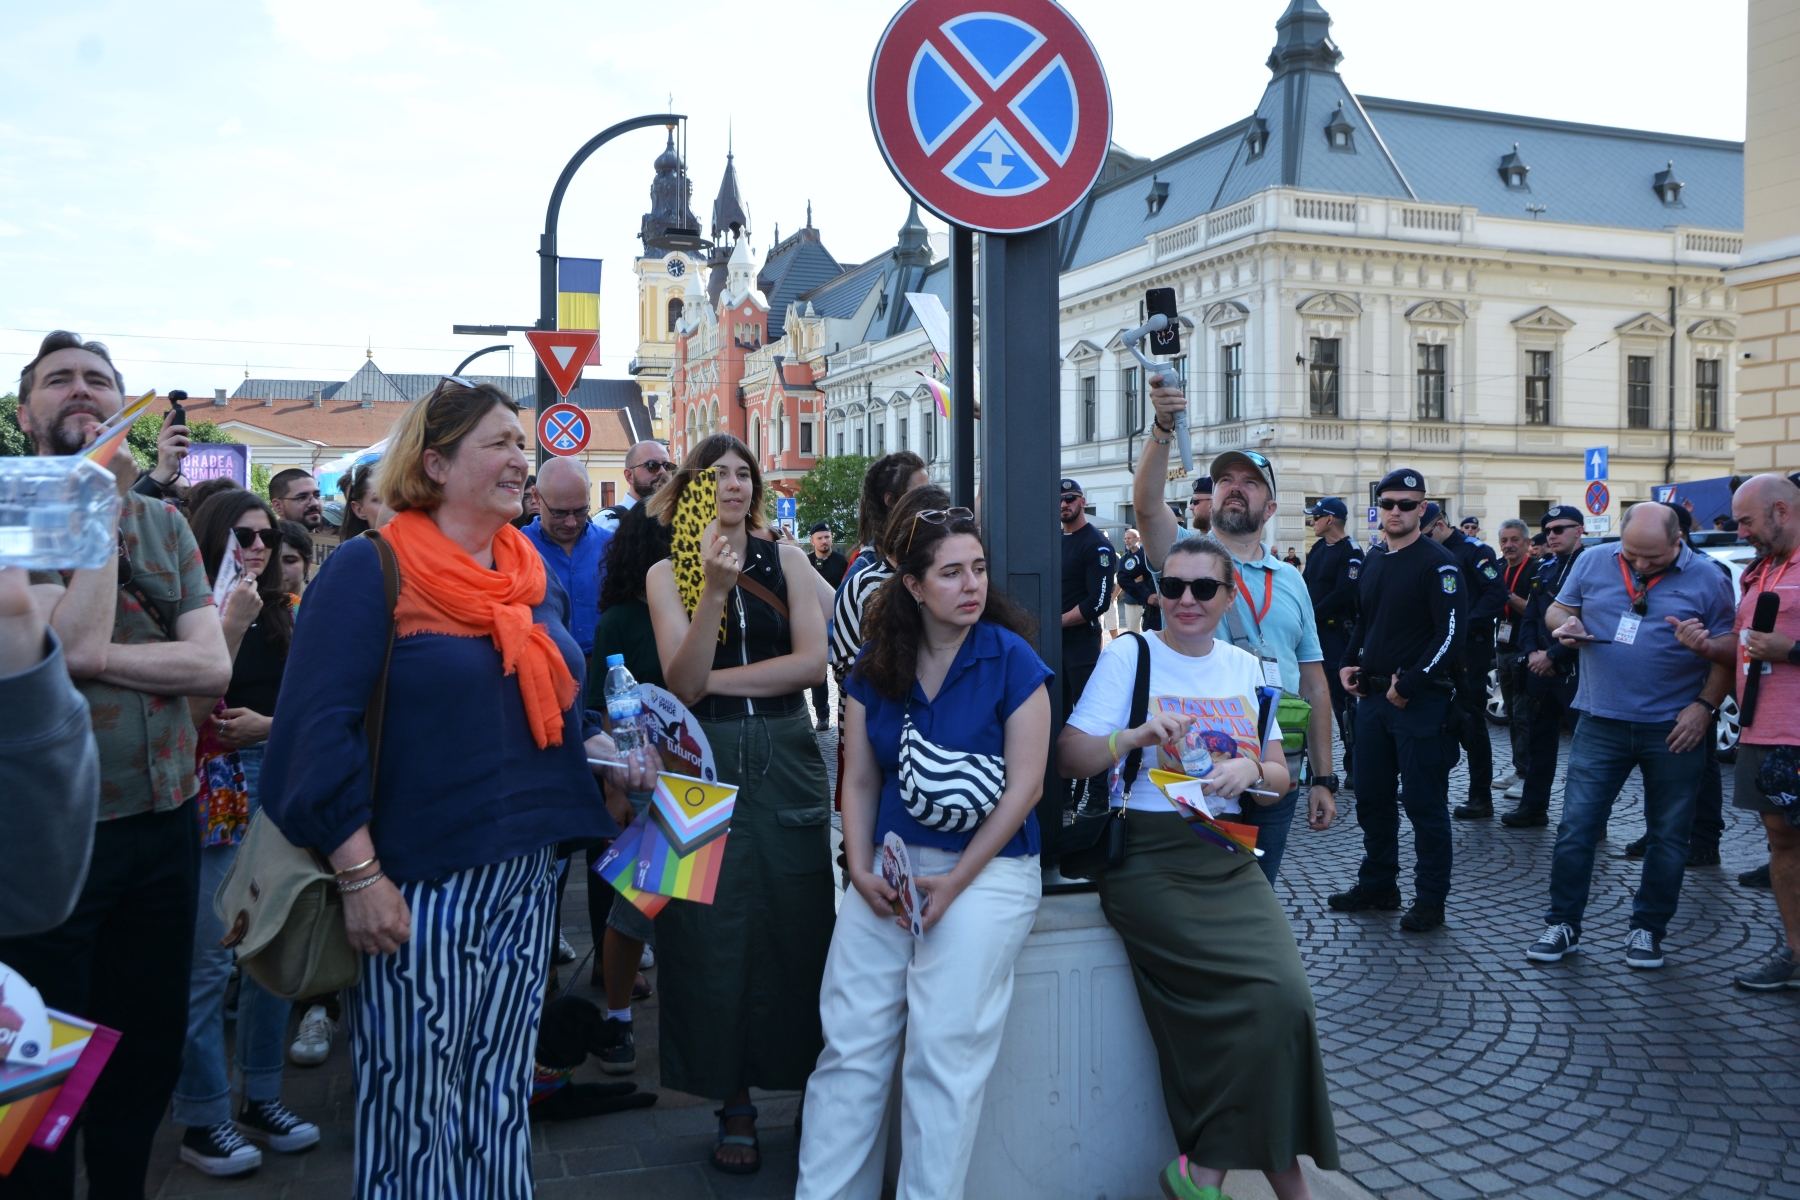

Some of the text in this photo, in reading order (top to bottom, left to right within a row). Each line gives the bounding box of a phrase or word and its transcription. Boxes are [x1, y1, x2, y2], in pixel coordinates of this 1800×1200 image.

[183, 467, 233, 480] SUMMER
[1369, 509, 1376, 521] P
[1423, 608, 1456, 674] JANDARMERIA
[658, 700, 677, 717] PRIDE
[1157, 697, 1245, 718] DAVID
